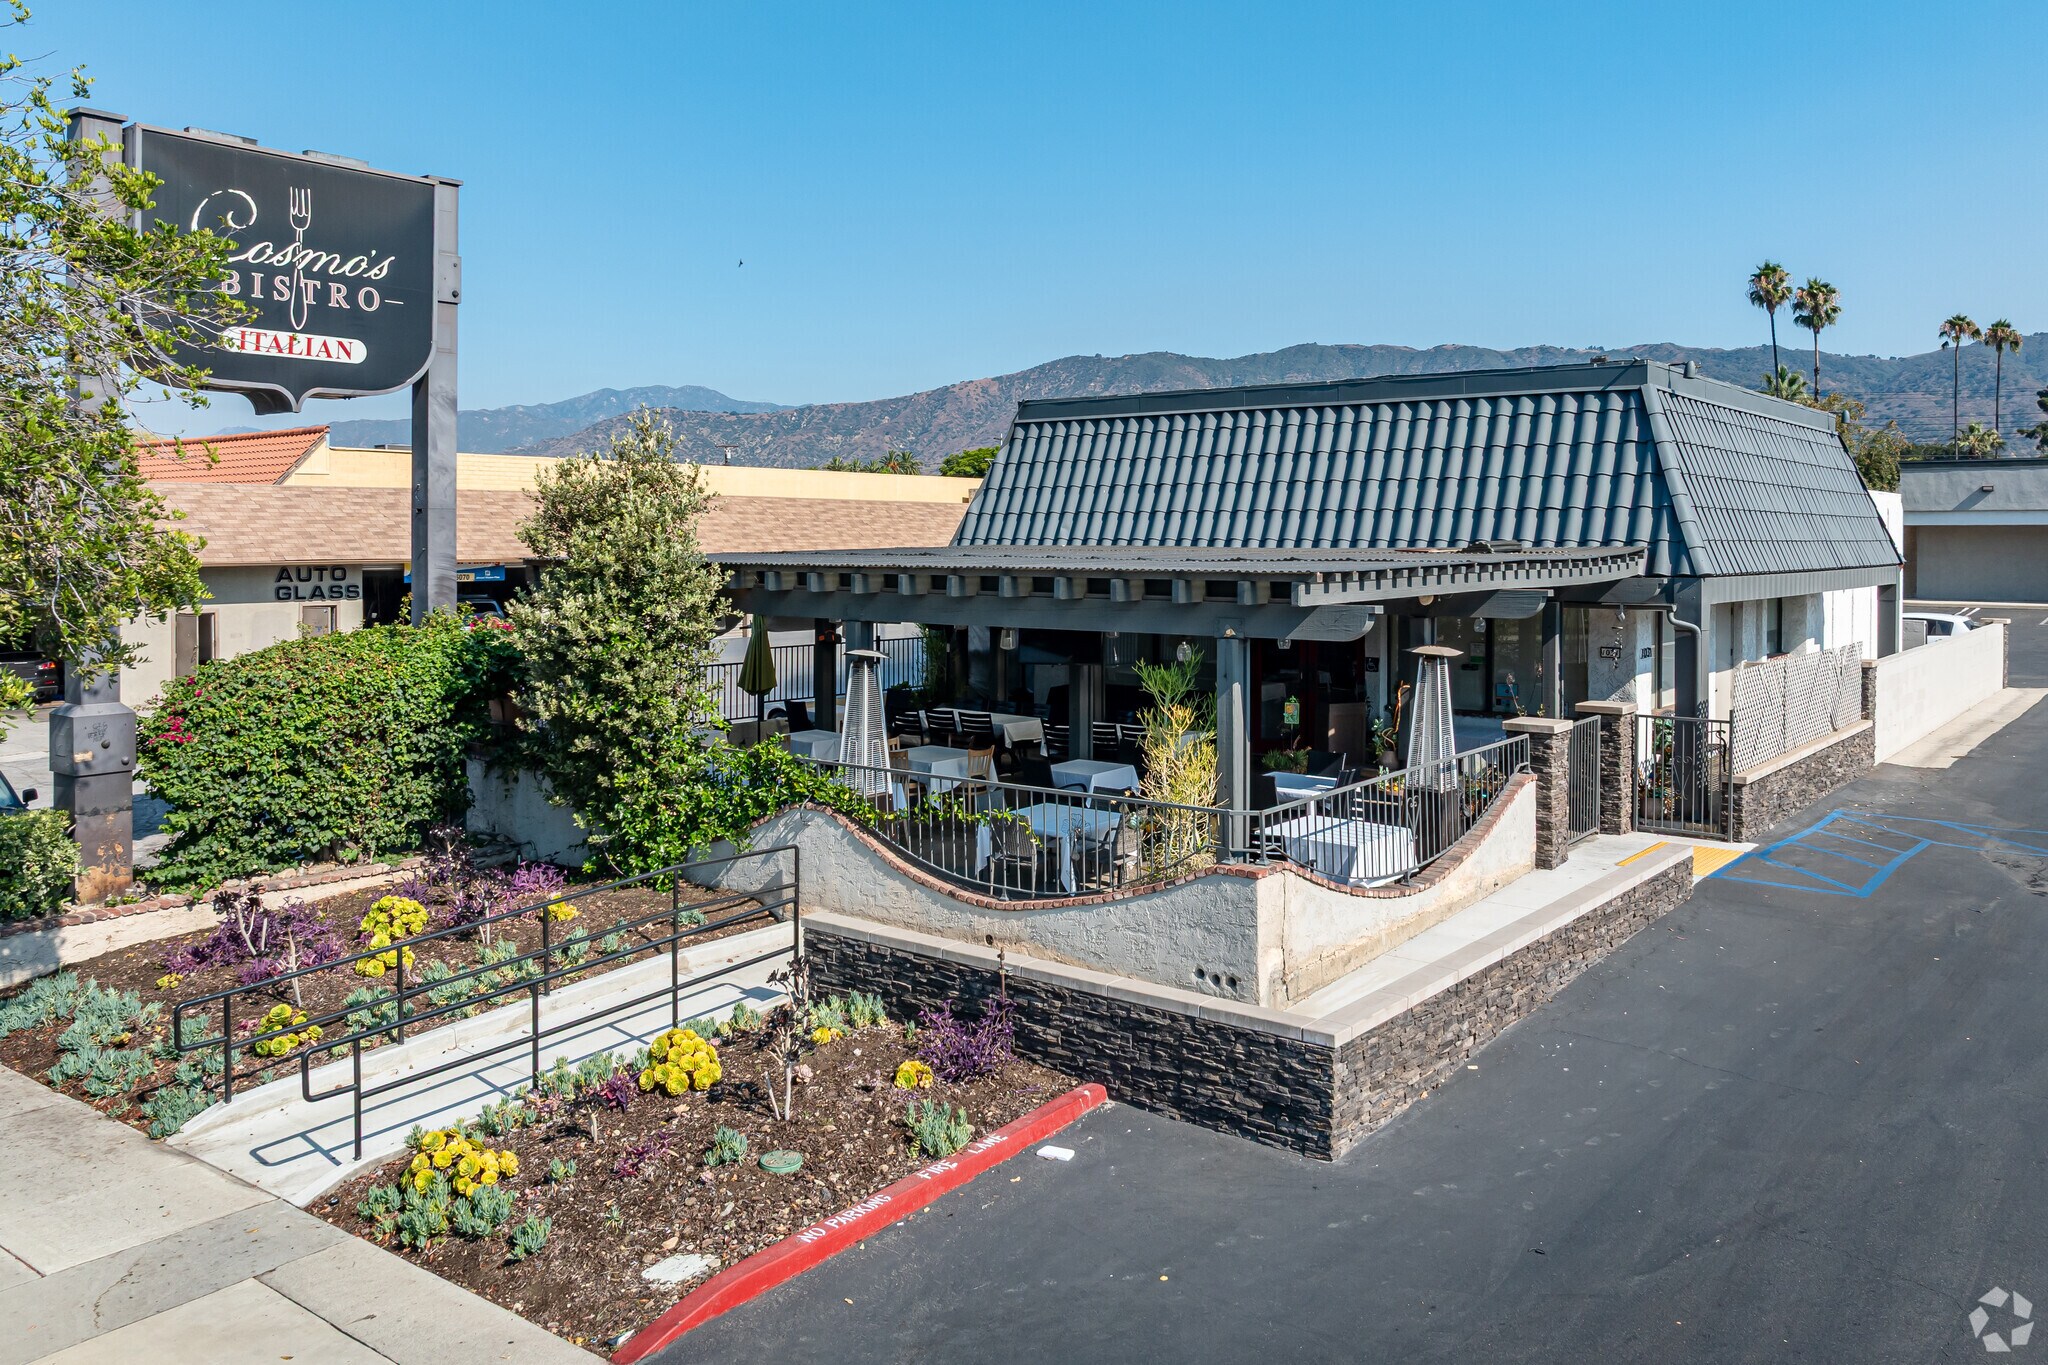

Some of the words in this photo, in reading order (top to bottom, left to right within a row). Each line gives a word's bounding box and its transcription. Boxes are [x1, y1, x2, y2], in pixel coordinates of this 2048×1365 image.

[191, 188, 396, 280] Cosmo's
[219, 269, 381, 312] BISTRO
[239, 330, 354, 360] ITALIAN
[275, 566, 347, 582] AUTO
[275, 585, 360, 600] GLASS
[797, 1227, 826, 1243] NO
[824, 1194, 892, 1229] PARKING
[917, 1159, 958, 1180] FIRE
[967, 1133, 1009, 1154] LANE
